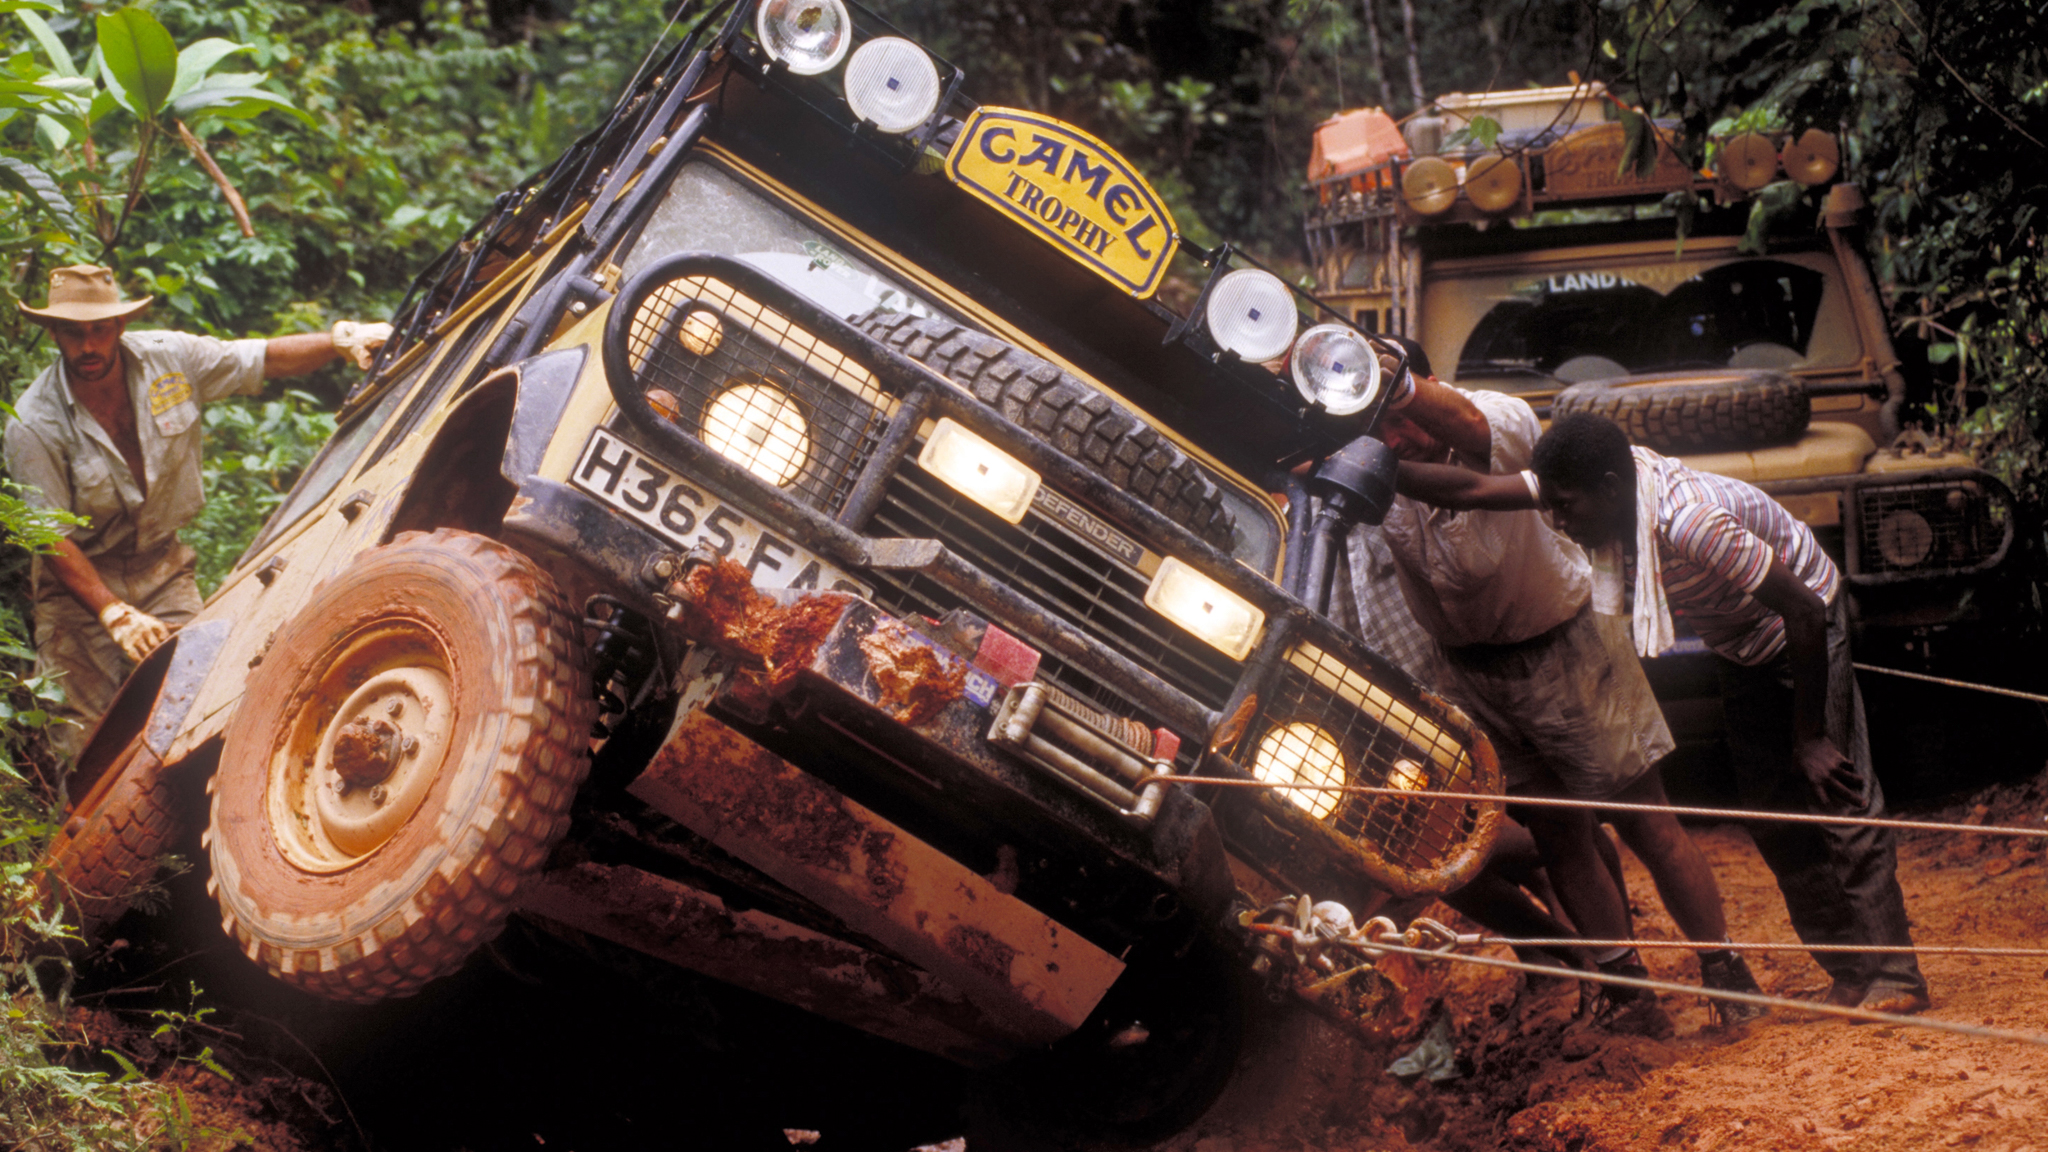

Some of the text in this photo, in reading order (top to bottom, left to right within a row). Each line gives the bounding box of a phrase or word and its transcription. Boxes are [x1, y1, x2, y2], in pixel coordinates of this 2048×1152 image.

[980, 127, 1158, 260] CAMEL
[1003, 170, 1118, 257] TROPHY
[813, 245, 847, 268] LAND
[1549, 272, 1616, 293] LAND
[864, 275, 946, 322] LAN
[581, 436, 744, 557] H365
[1034, 488, 1134, 558] DEFENDER
